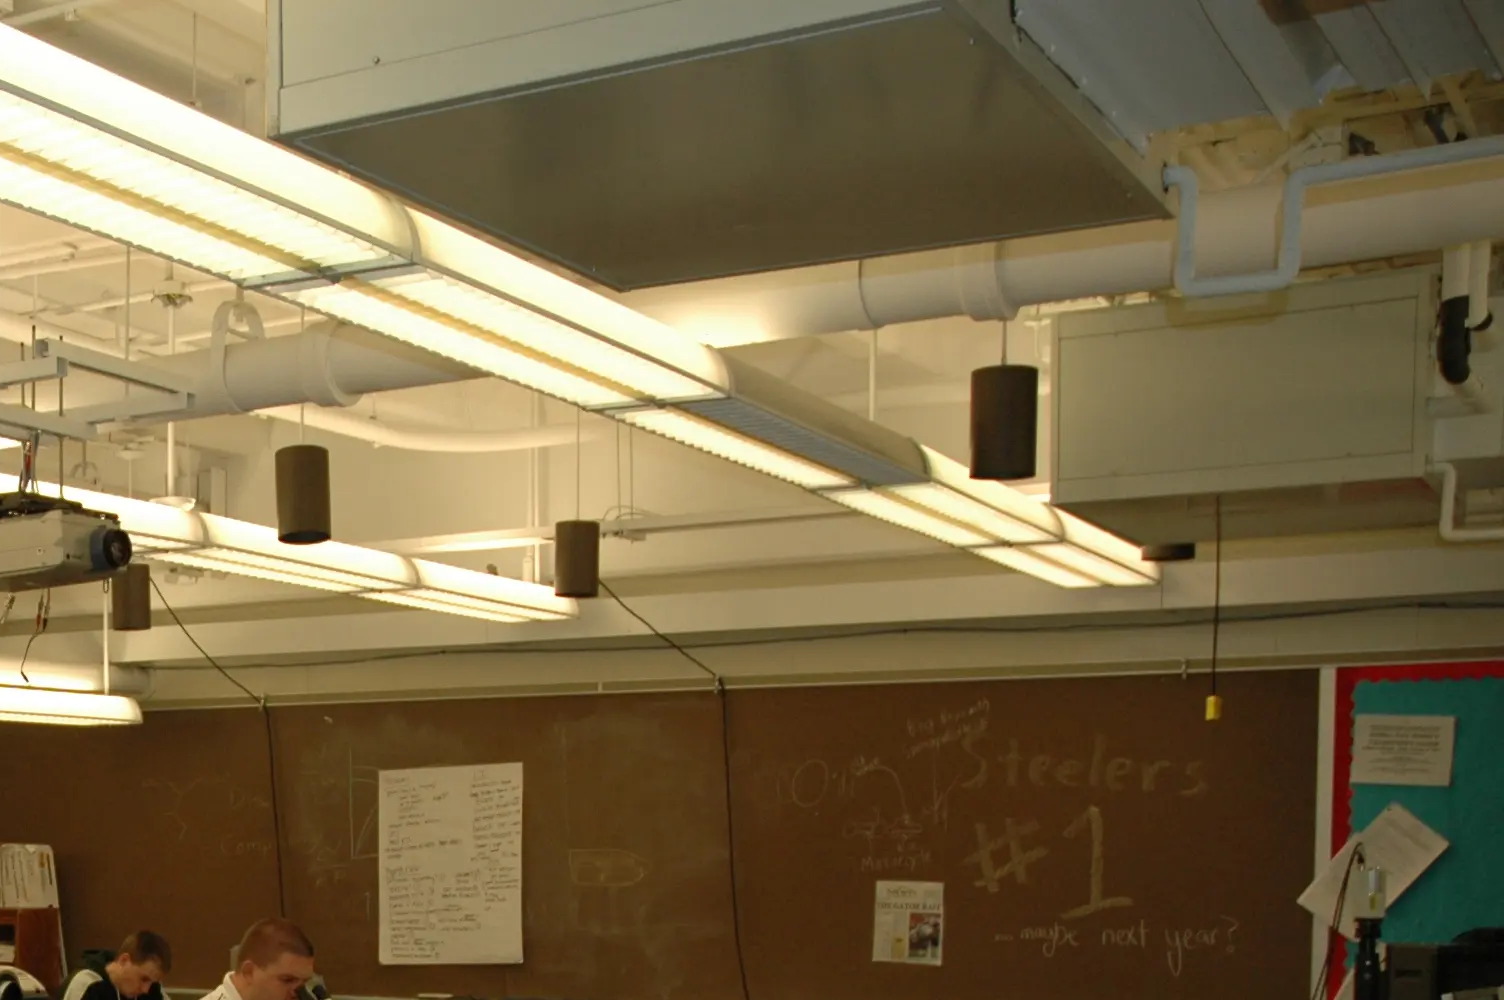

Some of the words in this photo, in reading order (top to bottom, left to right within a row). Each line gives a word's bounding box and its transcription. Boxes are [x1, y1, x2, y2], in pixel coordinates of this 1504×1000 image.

[960, 729, 1209, 797] Steelers
[1101, 919, 1151, 949] next
[1164, 914, 1241, 977] year?
